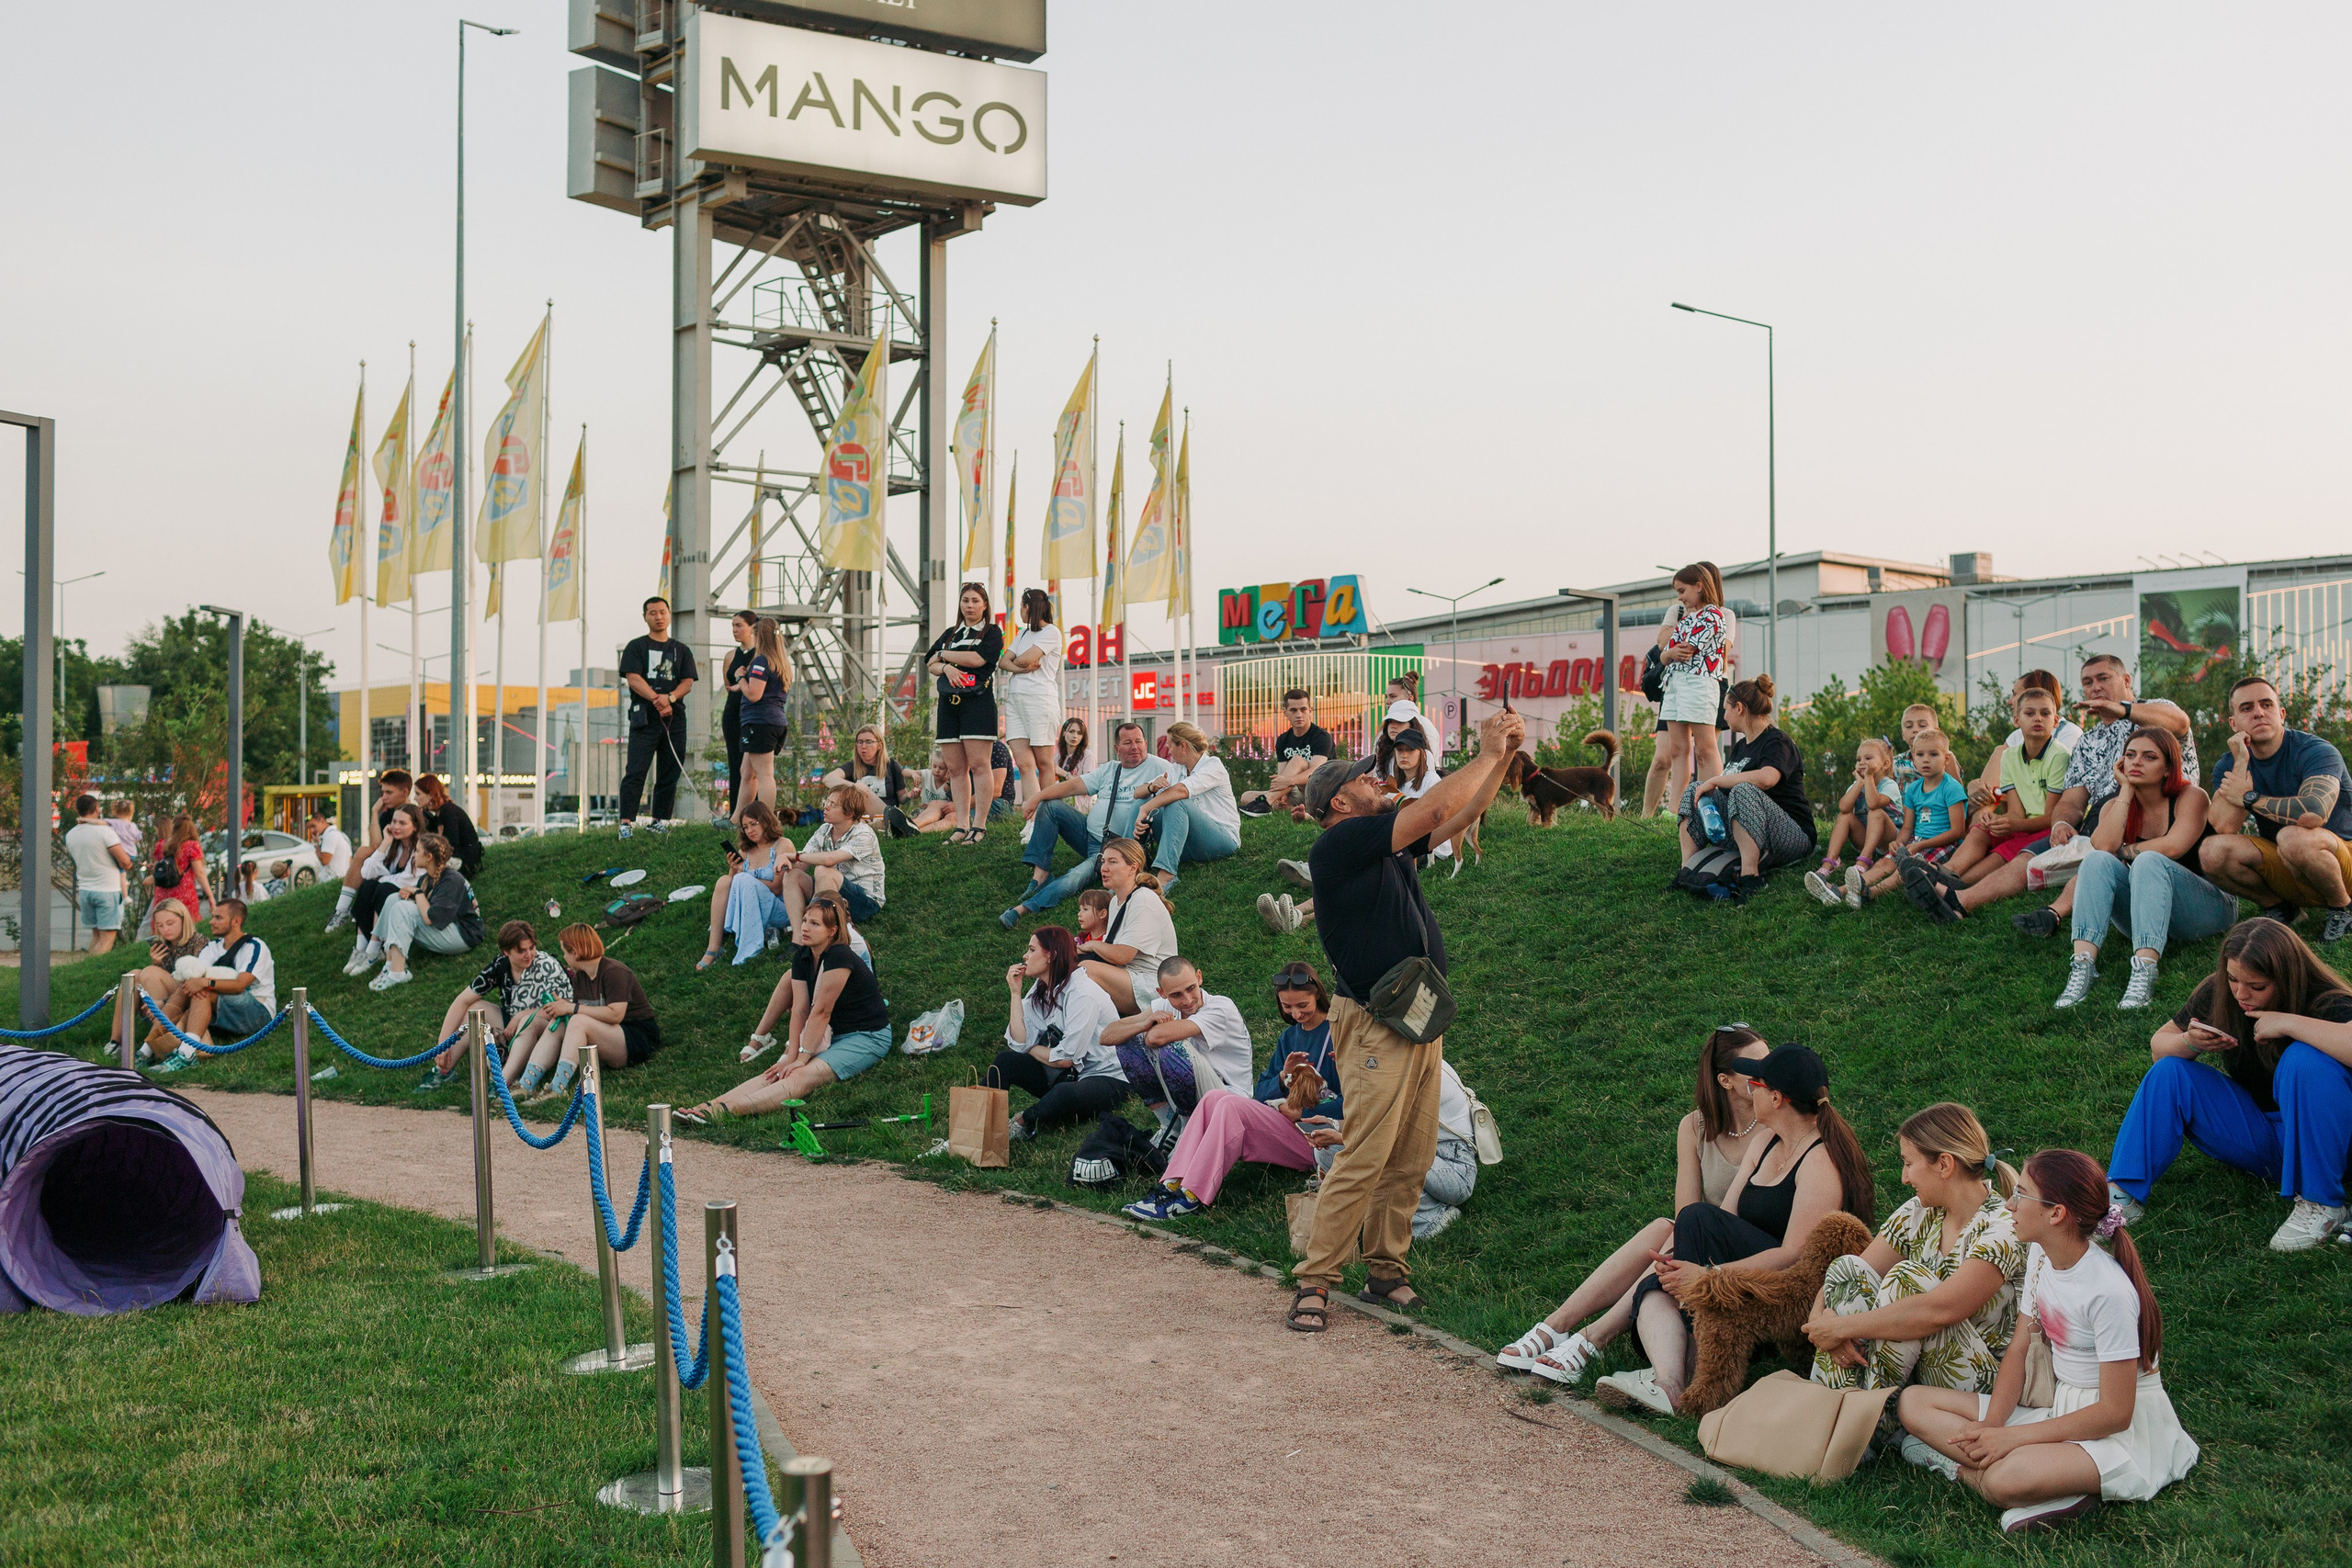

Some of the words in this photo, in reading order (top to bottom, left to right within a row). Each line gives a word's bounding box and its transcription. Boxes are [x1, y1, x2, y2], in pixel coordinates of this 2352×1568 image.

[721, 56, 1027, 154] MANGO
[1134, 682, 1156, 699] JC
[1475, 655, 1645, 700] ЭЛЬДОРА
[1403, 982, 1438, 1037] NIKE
[1073, 1158, 1115, 1179] PUMA
